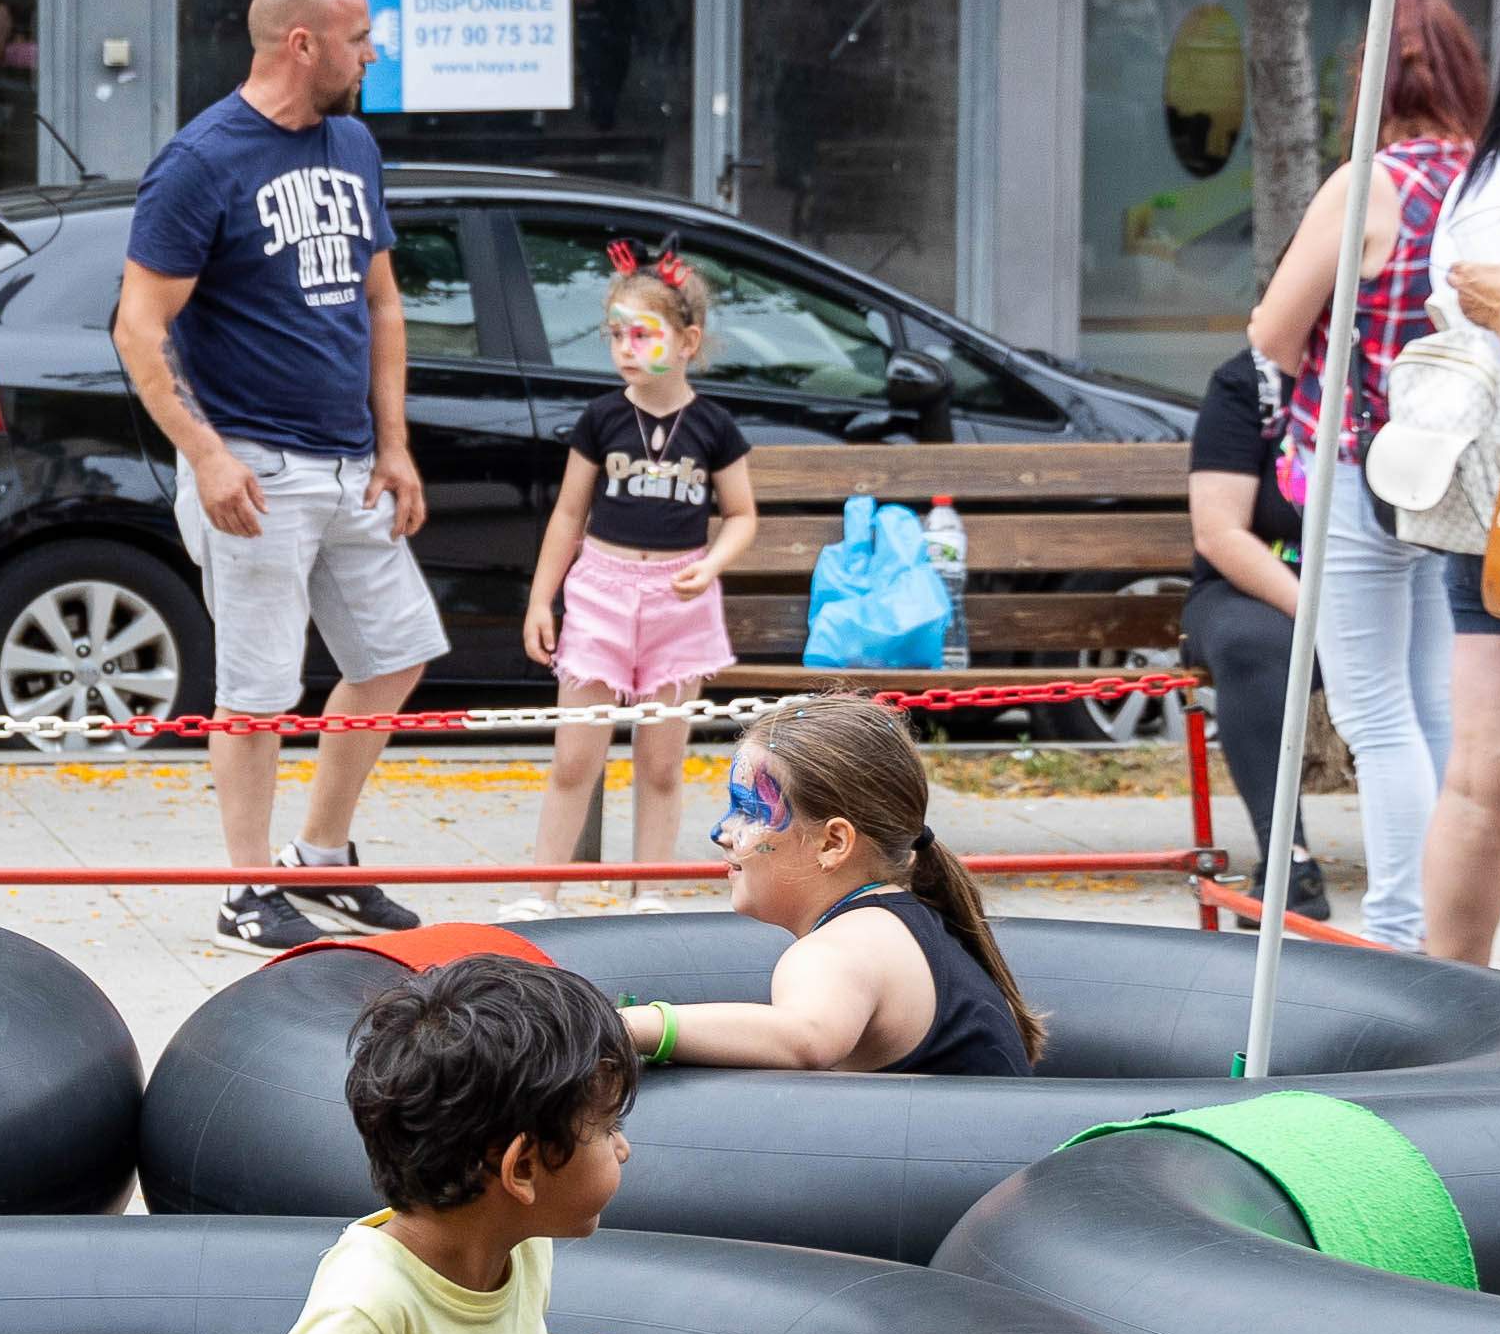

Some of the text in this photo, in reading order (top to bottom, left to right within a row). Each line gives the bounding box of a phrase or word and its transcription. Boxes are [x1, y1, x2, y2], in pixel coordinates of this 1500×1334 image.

[415, 25, 453, 48] 917
[461, 24, 489, 47] 90
[495, 23, 522, 47] 75
[528, 23, 555, 46] 32
[256, 167, 372, 256] SUNSET
[298, 234, 362, 289] BLVD.
[304, 288, 356, 306] LOS ANGELES
